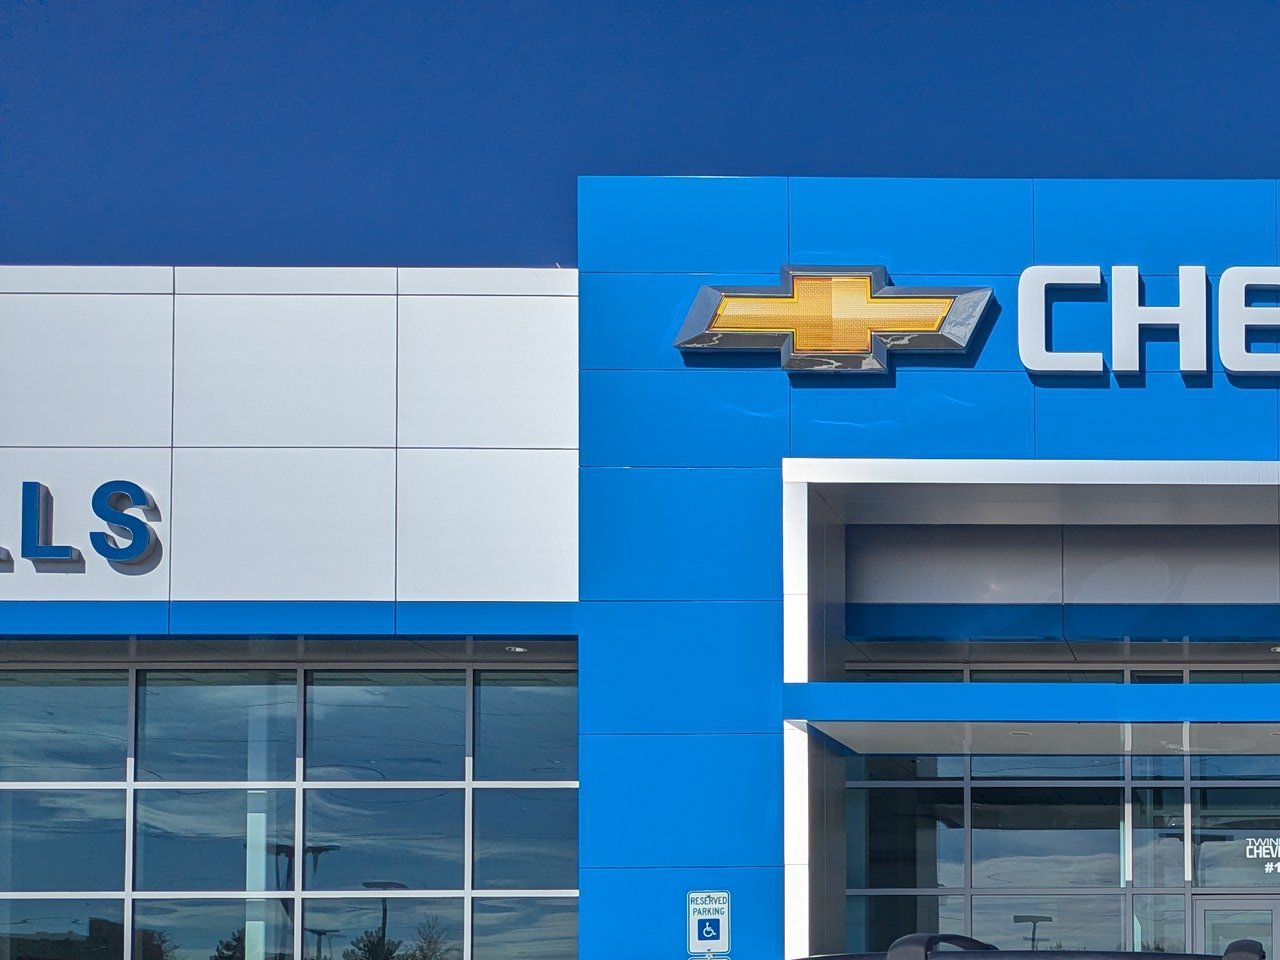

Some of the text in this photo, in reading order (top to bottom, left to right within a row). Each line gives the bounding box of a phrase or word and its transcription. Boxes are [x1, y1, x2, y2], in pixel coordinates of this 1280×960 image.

[0, 479, 151, 562] LS
[690, 896, 728, 905] RESERVED
[692, 907, 725, 916] PARKING
